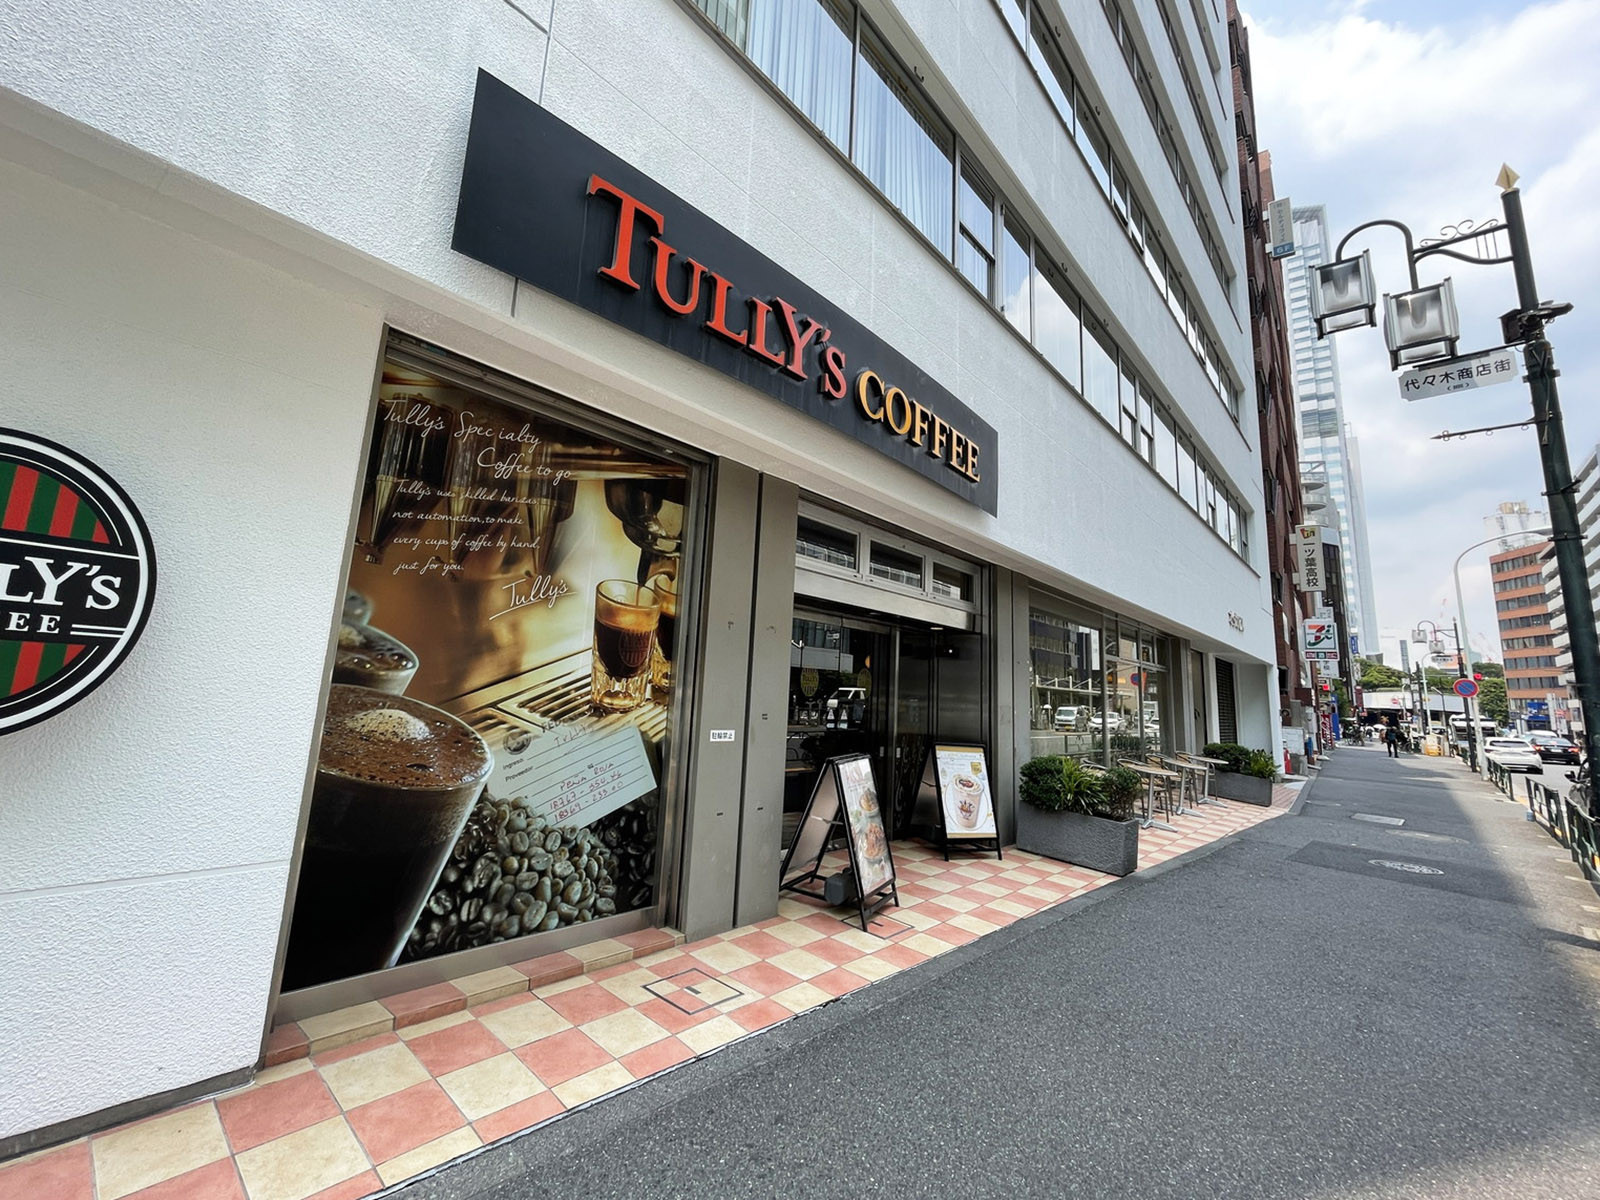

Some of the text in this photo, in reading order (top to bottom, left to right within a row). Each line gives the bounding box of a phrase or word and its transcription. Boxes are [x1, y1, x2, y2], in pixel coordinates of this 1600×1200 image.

[585, 173, 981, 483] TULLY'S COFFEE
[1404, 358, 1511, 391] 代々木商店街
[384, 400, 446, 438] Tully's
[477, 447, 573, 486] Coffee to go
[396, 479, 431, 500] Tully's
[460, 486, 498, 501] skilled
[392, 511, 413, 519] not
[497, 512, 525, 525] make
[393, 537, 422, 550] every
[450, 533, 466, 550] of
[466, 534, 493, 551] coffee
[496, 535, 507, 552] by
[393, 560, 419, 575] just
[420, 556, 438, 574] for
[1303, 543, 1319, 587] 一ツ葉高校
[502, 574, 569, 608] Tully's
